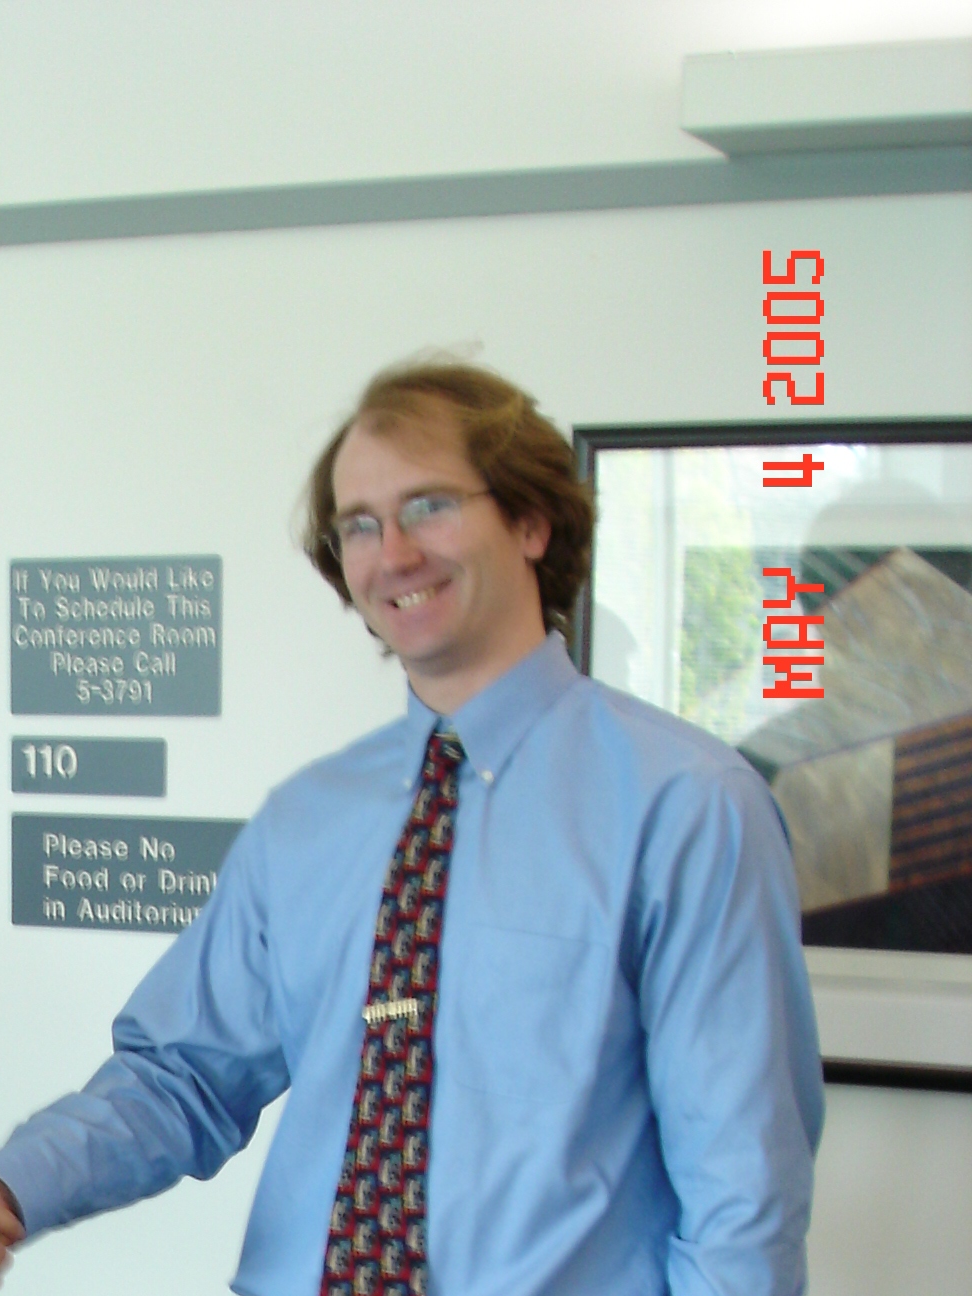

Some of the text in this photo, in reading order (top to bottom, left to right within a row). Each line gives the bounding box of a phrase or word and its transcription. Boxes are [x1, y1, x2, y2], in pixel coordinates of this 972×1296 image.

[13, 565, 214, 593] If You Would Like
[18, 593, 212, 622] To Schedule This
[13, 622, 216, 649] Conference Room
[51, 650, 176, 677] Please Call
[76, 679, 152, 705] 5-3791
[21, 743, 78, 780] 110
[42, 832, 176, 862] Please No
[42, 864, 109, 891] Food
[120, 871, 146, 893] or
[42, 897, 66, 921] in
